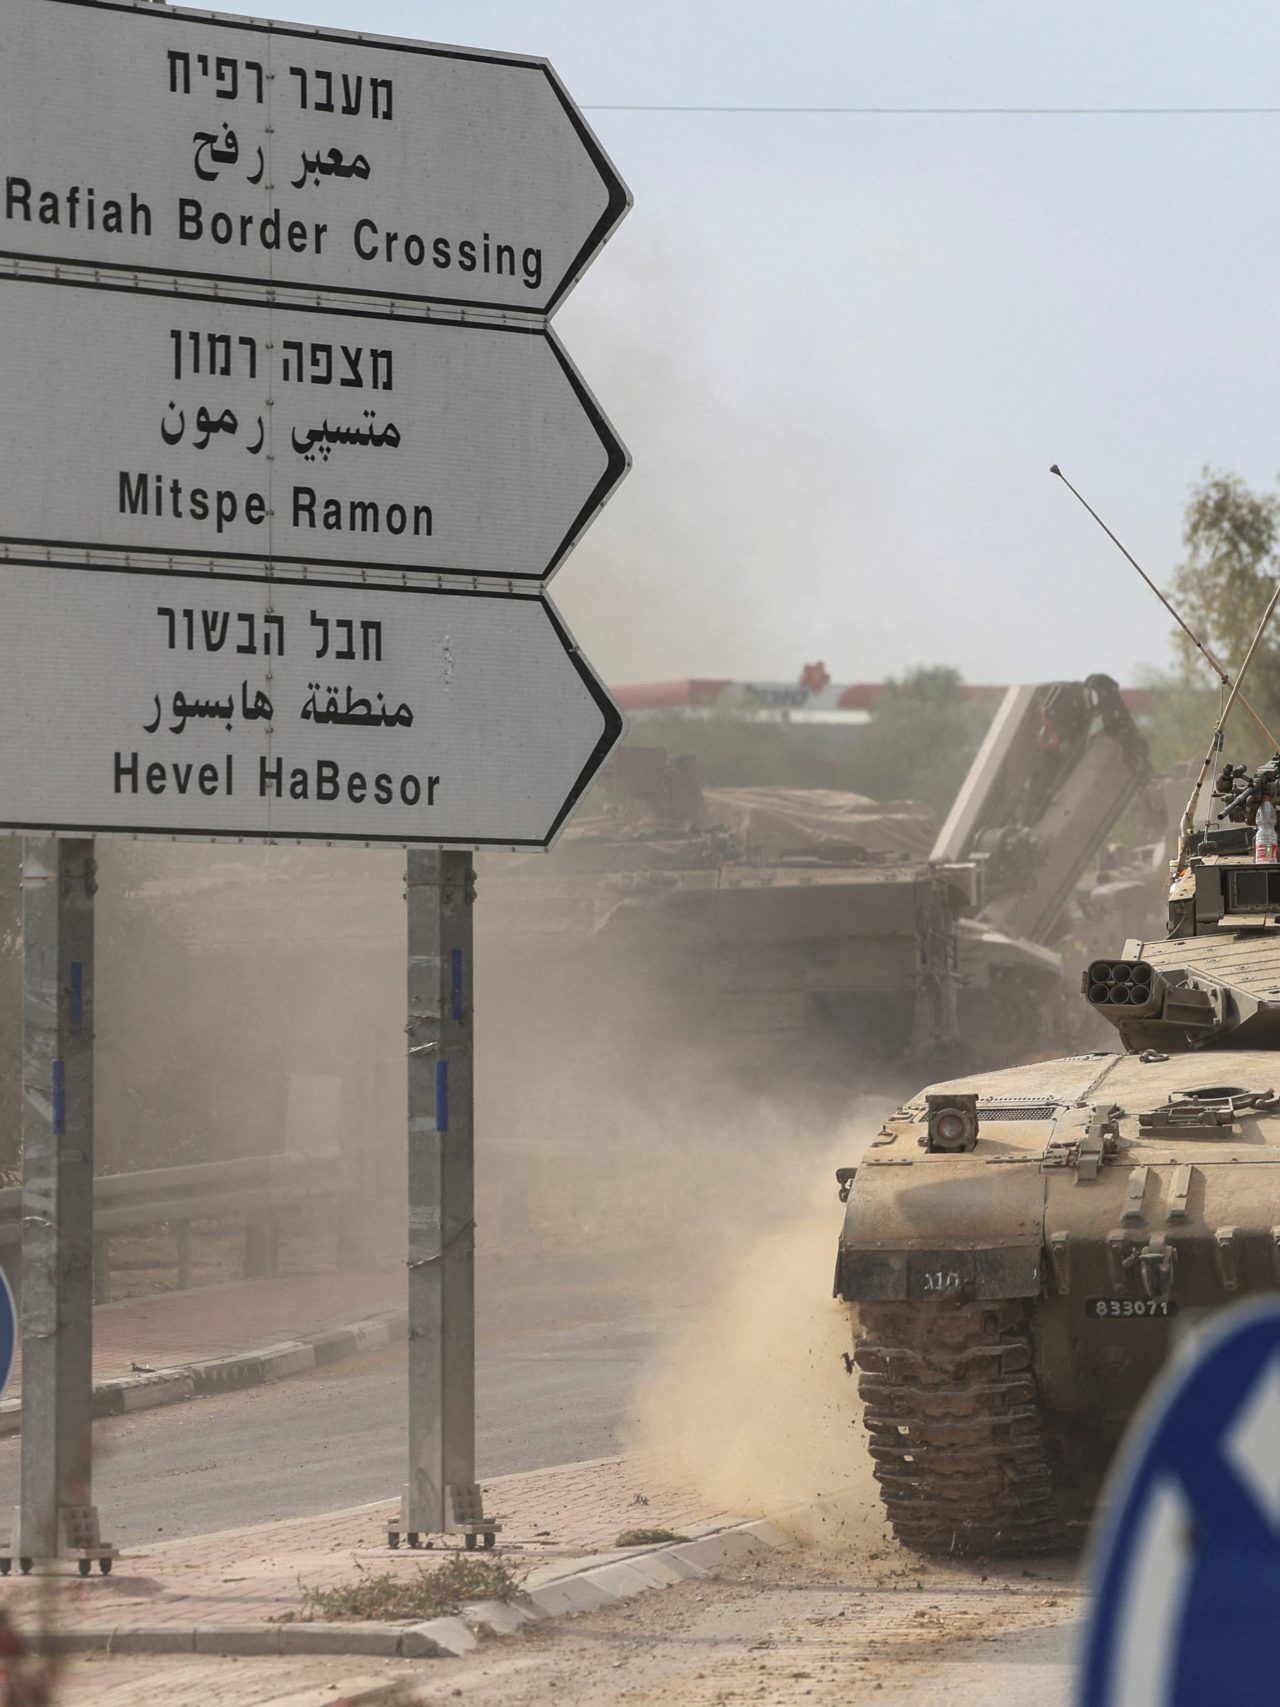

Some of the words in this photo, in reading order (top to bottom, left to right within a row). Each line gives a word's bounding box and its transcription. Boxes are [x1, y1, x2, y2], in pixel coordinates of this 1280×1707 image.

[168, 50, 263, 103] רפיח
[290, 67, 393, 120] מעבר
[193, 122, 264, 185] رفح
[291, 147, 371, 189] معبر
[5, 177, 152, 235] Rafiah
[179, 198, 328, 254] Border
[354, 218, 542, 288] Crossing
[170, 330, 257, 379] רמון
[283, 340, 393, 390] מצפה
[161, 401, 264, 454] رمون
[119, 471, 266, 533] Mitspe
[292, 486, 433, 536] Ramon
[157, 606, 284, 656] הבשור
[311, 610, 382, 661] חבל
[143, 680, 273, 734] هابسور
[301, 683, 414, 728] منطقة
[114, 752, 233, 796] Hevel
[259, 756, 440, 806] HaBesor
[1096, 1300, 1168, 1316] 833071
